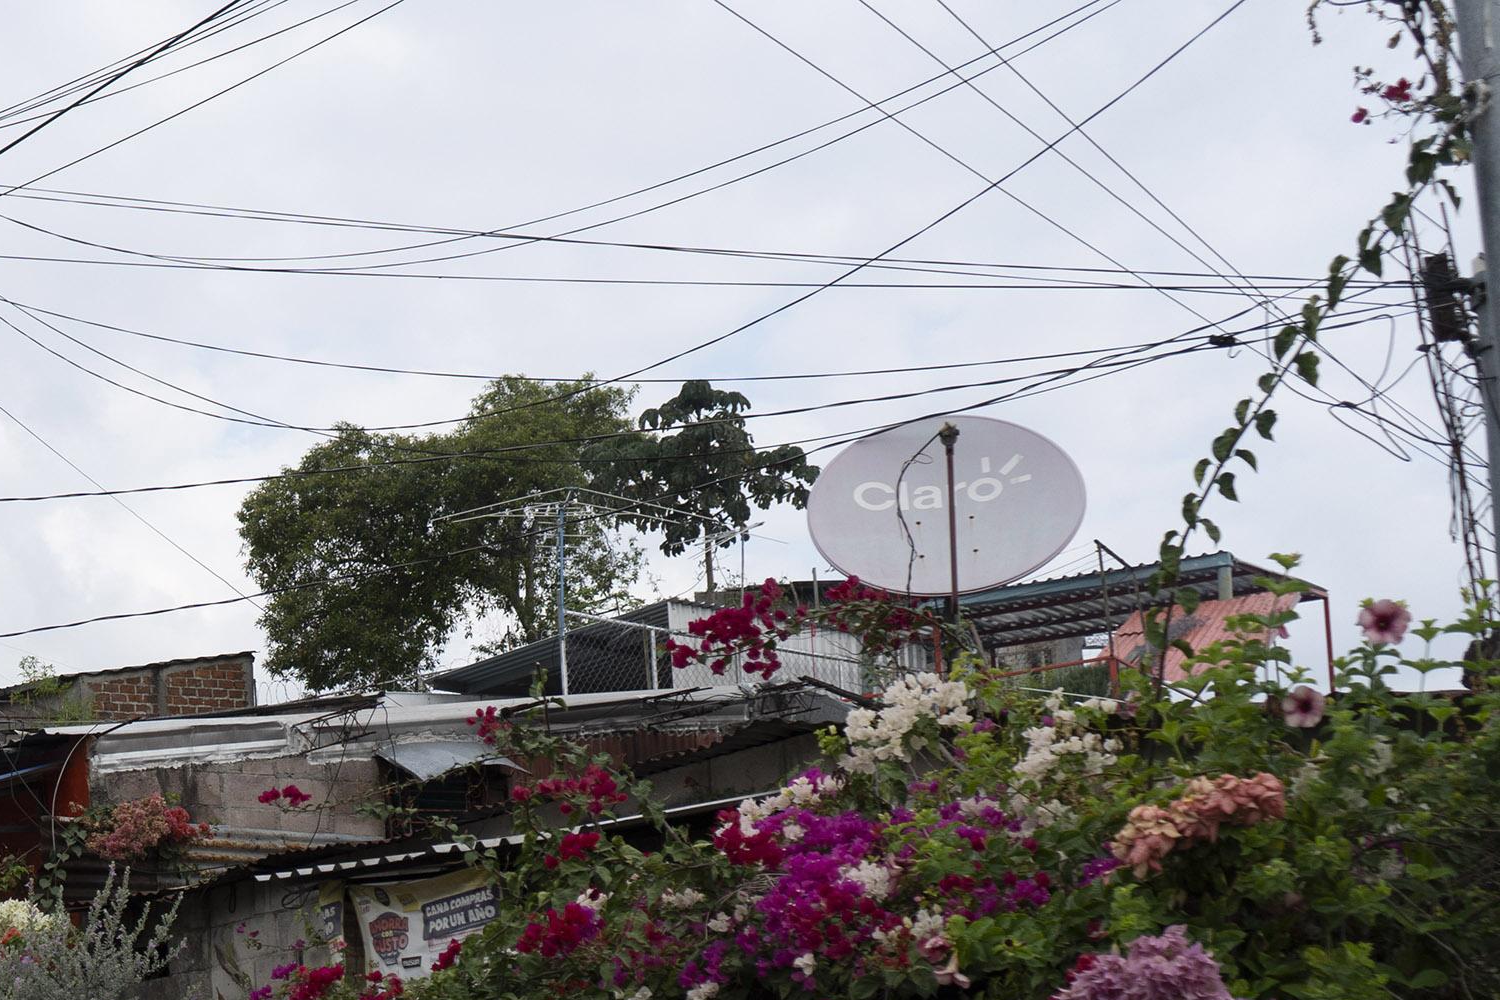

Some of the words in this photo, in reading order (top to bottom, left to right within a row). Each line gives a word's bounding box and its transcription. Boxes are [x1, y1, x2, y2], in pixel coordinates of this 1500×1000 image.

[853, 476, 1004, 512] Claro
[426, 902, 450, 918] GANA
[450, 889, 494, 909] COMPRAS
[429, 917, 450, 933] POR
[450, 911, 466, 926] UN
[468, 904, 496, 923] AÑO
